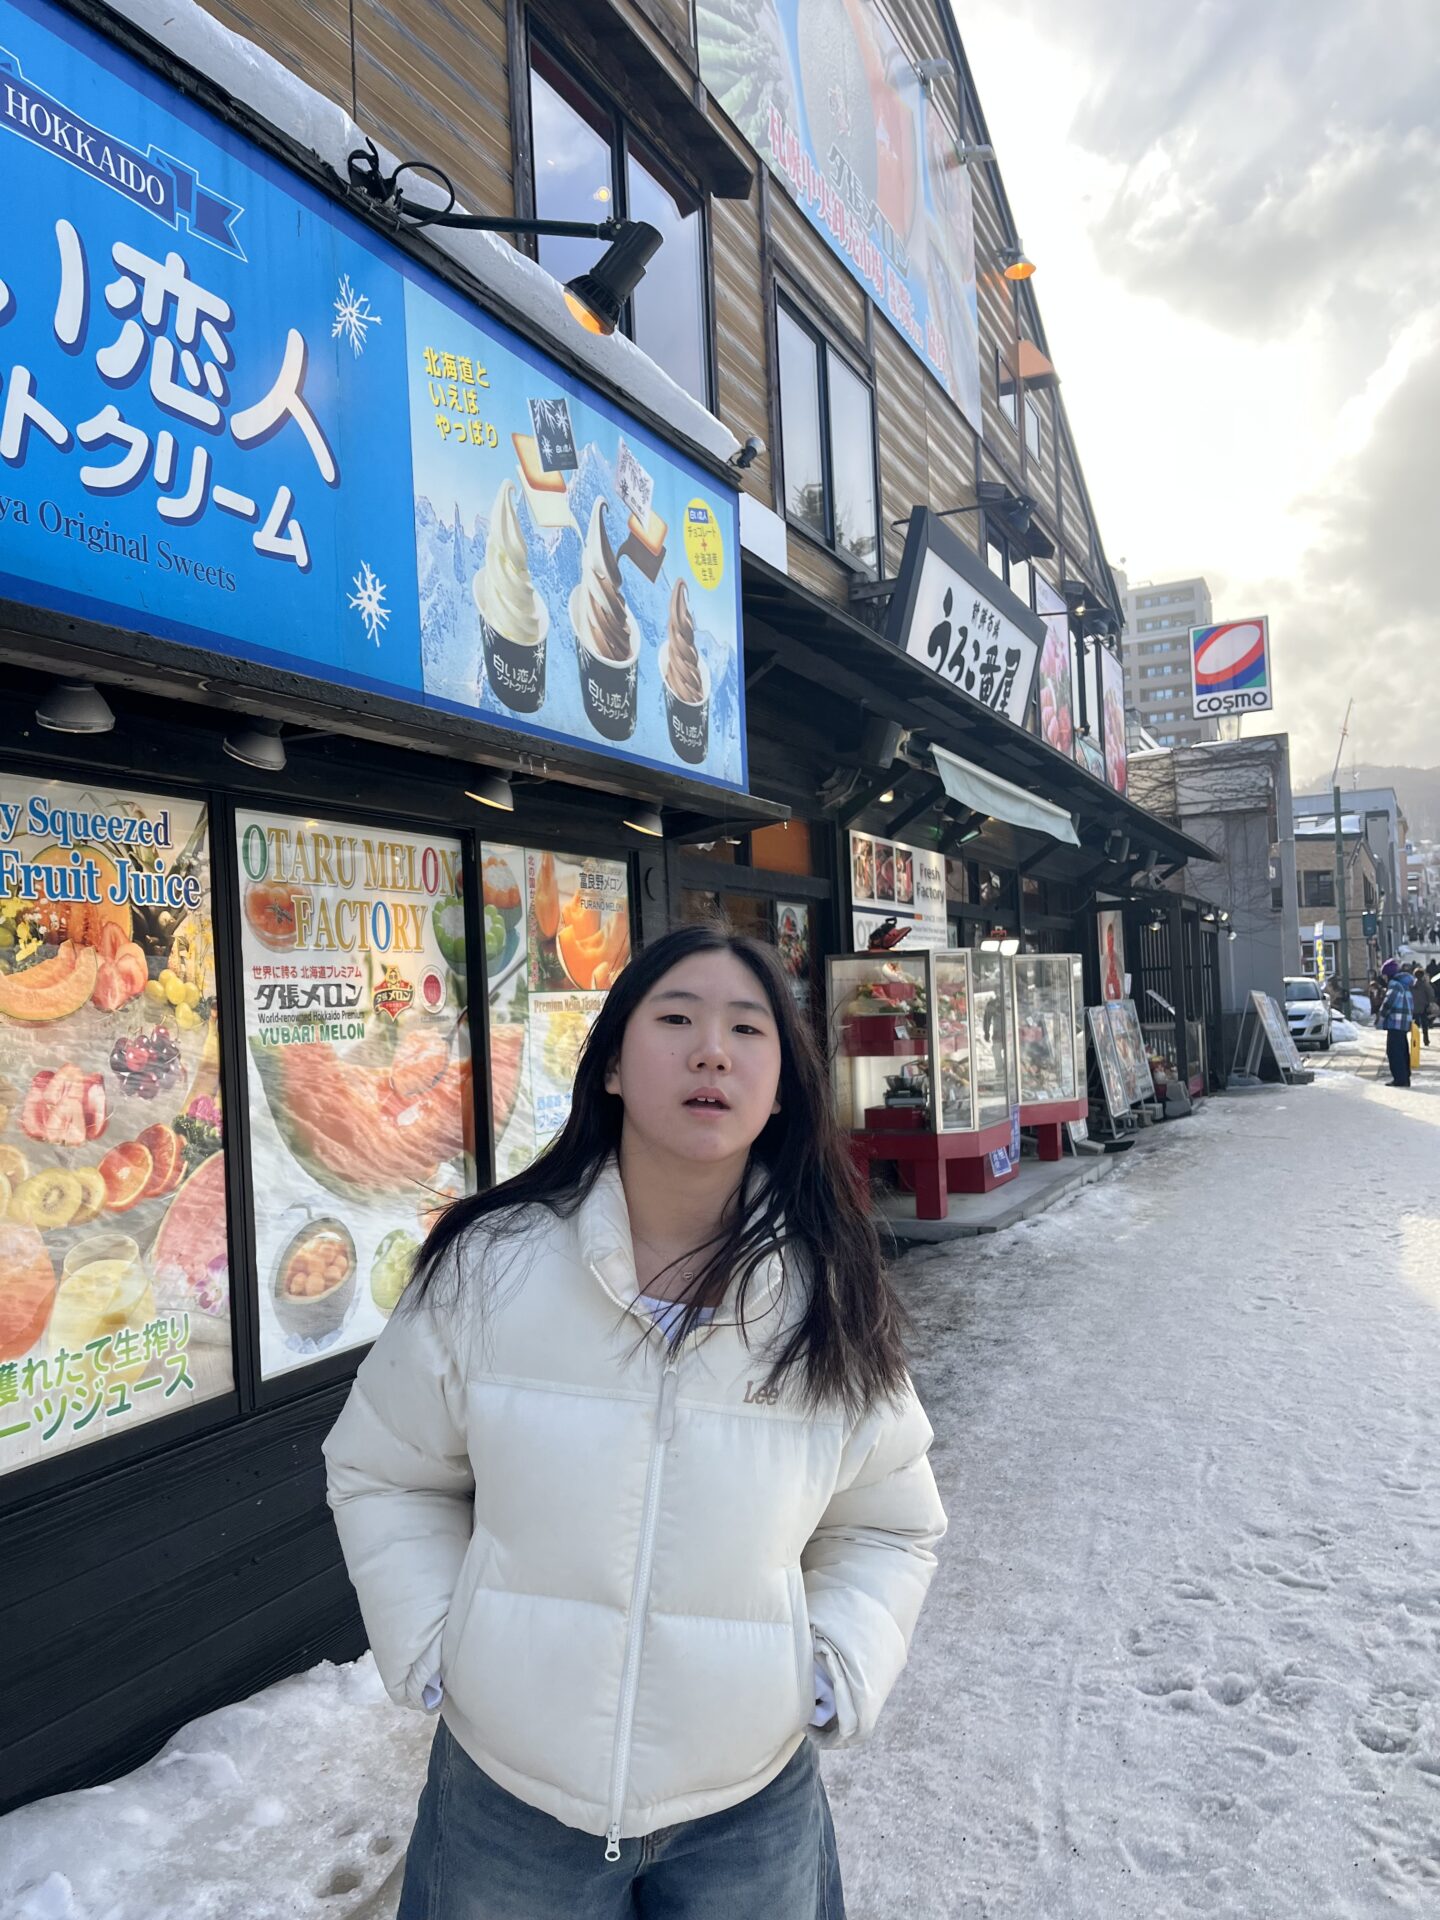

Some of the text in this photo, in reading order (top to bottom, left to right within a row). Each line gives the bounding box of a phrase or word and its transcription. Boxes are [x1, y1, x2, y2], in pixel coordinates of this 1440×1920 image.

[4, 83, 165, 206] HOKKAIDO
[423, 346, 490, 389] 北海道と
[429, 381, 480, 415] いえば
[435, 413, 498, 449] やっぱり
[39, 500, 150, 563] Original
[157, 540, 237, 593] Sweets
[927, 587, 1021, 720] うろこ番屋
[493, 654, 538, 684] 白い恋人
[496, 671, 536, 694] ソフトクリーム
[588, 678, 631, 709] 白い恋人
[591, 696, 629, 720] ソフトクリーム
[672, 715, 704, 739] 白い恋人
[28, 796, 171, 849] Squeezed
[242, 824, 458, 896] OTARU MELON
[919, 862, 941, 881] Fresh
[0, 850, 201, 907] Fruit Juice
[579, 872, 624, 891] 富良野メロン
[916, 881, 945, 905] Factory
[580, 898, 605, 913] FURANO
[291, 895, 428, 952] FACTORY
[252, 965, 362, 980] 世界に誇る 北海道プレミアム
[254, 983, 363, 1011] 夕張メロン
[258, 1009, 366, 1024] World-renowned Hokkaido Premium
[259, 1023, 365, 1046] YUBARI MELON
[743, 1380, 780, 1406] Lee
